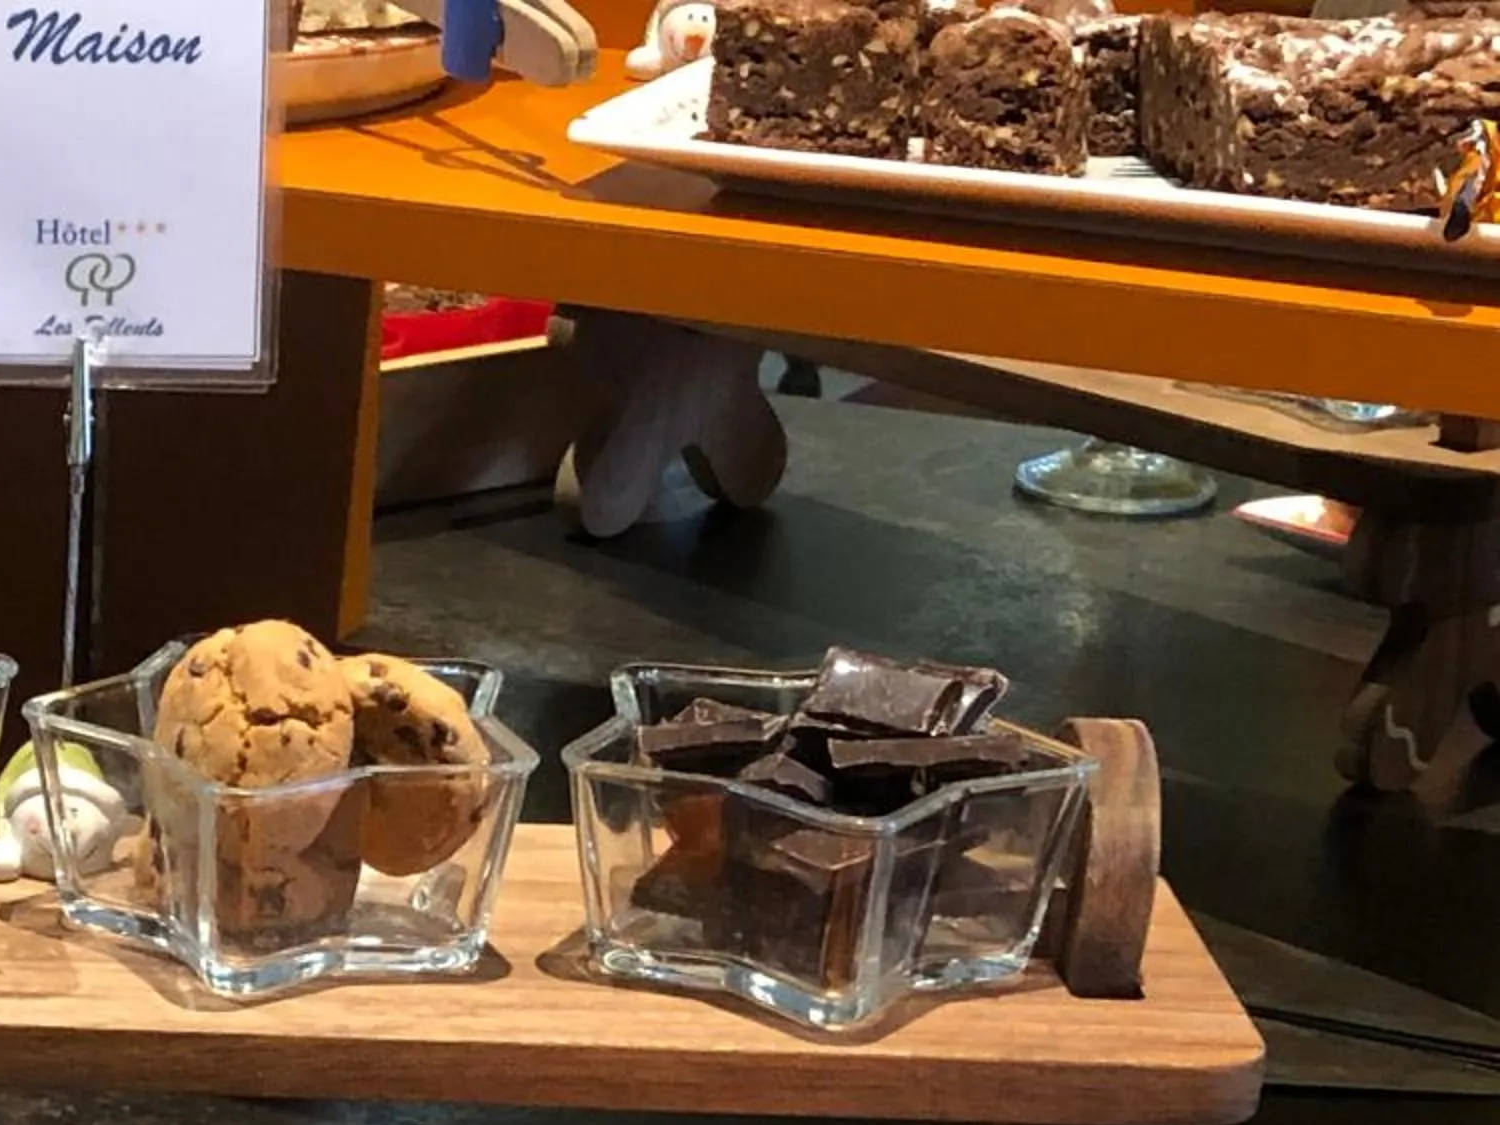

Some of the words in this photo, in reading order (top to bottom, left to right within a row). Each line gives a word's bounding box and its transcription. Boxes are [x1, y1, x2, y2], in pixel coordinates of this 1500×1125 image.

[6, 8, 202, 65] Maison
[36, 219, 110, 245] Hôtel
[34, 314, 73, 336] Les
